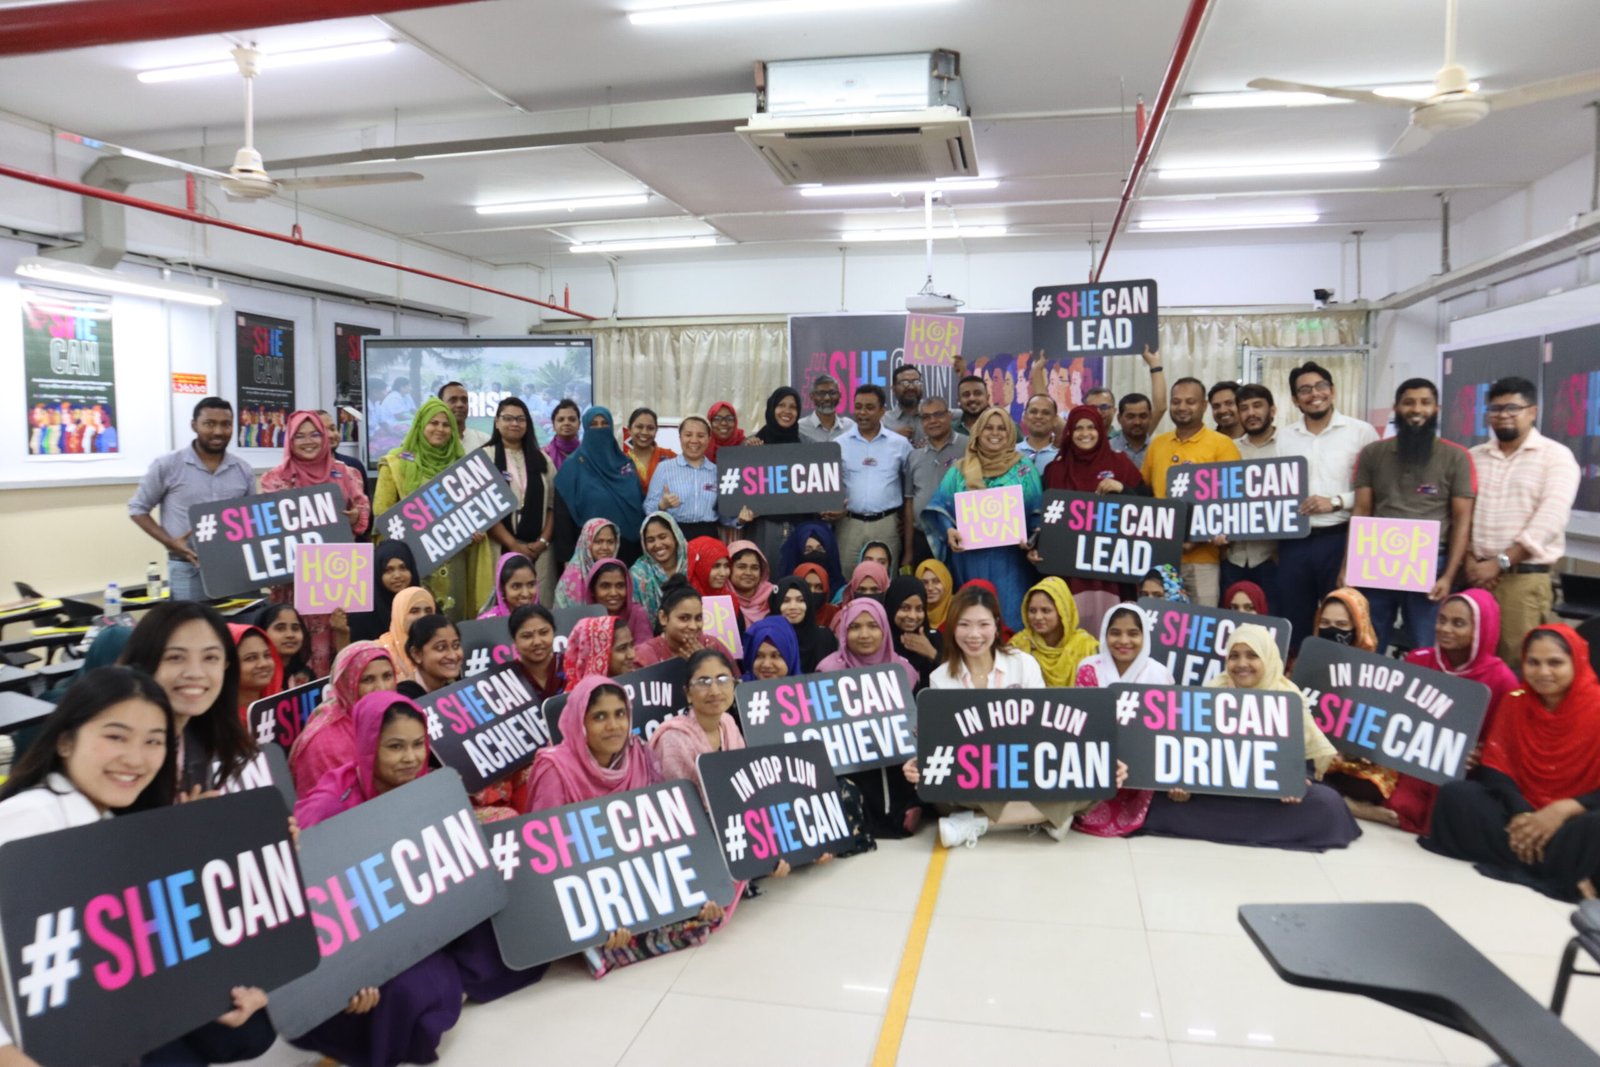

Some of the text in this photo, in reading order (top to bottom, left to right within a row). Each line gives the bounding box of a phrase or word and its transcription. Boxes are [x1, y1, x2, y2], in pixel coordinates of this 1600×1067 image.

[911, 319, 960, 346] HOP
[1067, 317, 1133, 352] LEAD
[50, 337, 100, 376] CAN
[914, 344, 957, 363] LUN
[419, 483, 510, 563] ACHIEVE
[961, 491, 1018, 523] HOP
[1190, 500, 1299, 536] ACHIEVE
[970, 517, 1020, 543] LUN
[1357, 523, 1433, 562] HOP
[302, 548, 368, 583] HOP
[1075, 535, 1152, 576] LEAD
[1363, 557, 1428, 586] LUN
[310, 580, 368, 607] LUN
[640, 681, 672, 707] LUN
[1329, 663, 1454, 720] IN HOP LUN
[955, 699, 1088, 738] IN HOP LUN
[783, 714, 916, 767] HIEVE
[730, 755, 817, 803] IN HOP LUN
[1155, 735, 1279, 790] DRIVE
[553, 845, 707, 942] DRIVE
